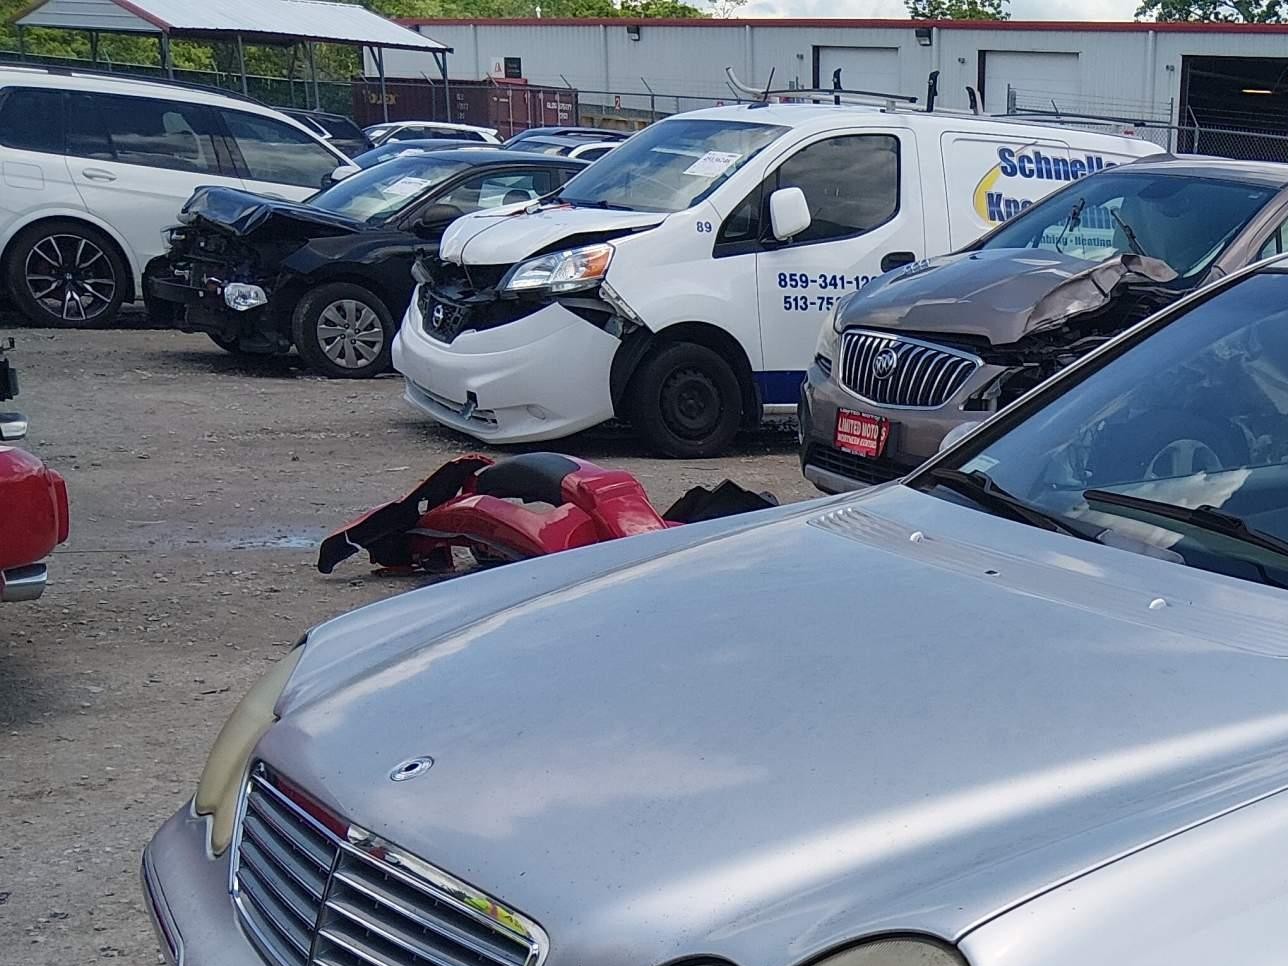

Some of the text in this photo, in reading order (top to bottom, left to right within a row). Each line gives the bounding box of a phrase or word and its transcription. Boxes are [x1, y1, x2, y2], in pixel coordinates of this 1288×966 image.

[696, 221, 712, 233] 89
[783, 295, 842, 311] 513-75
[838, 417, 887, 441] LIMITED MOTOS
